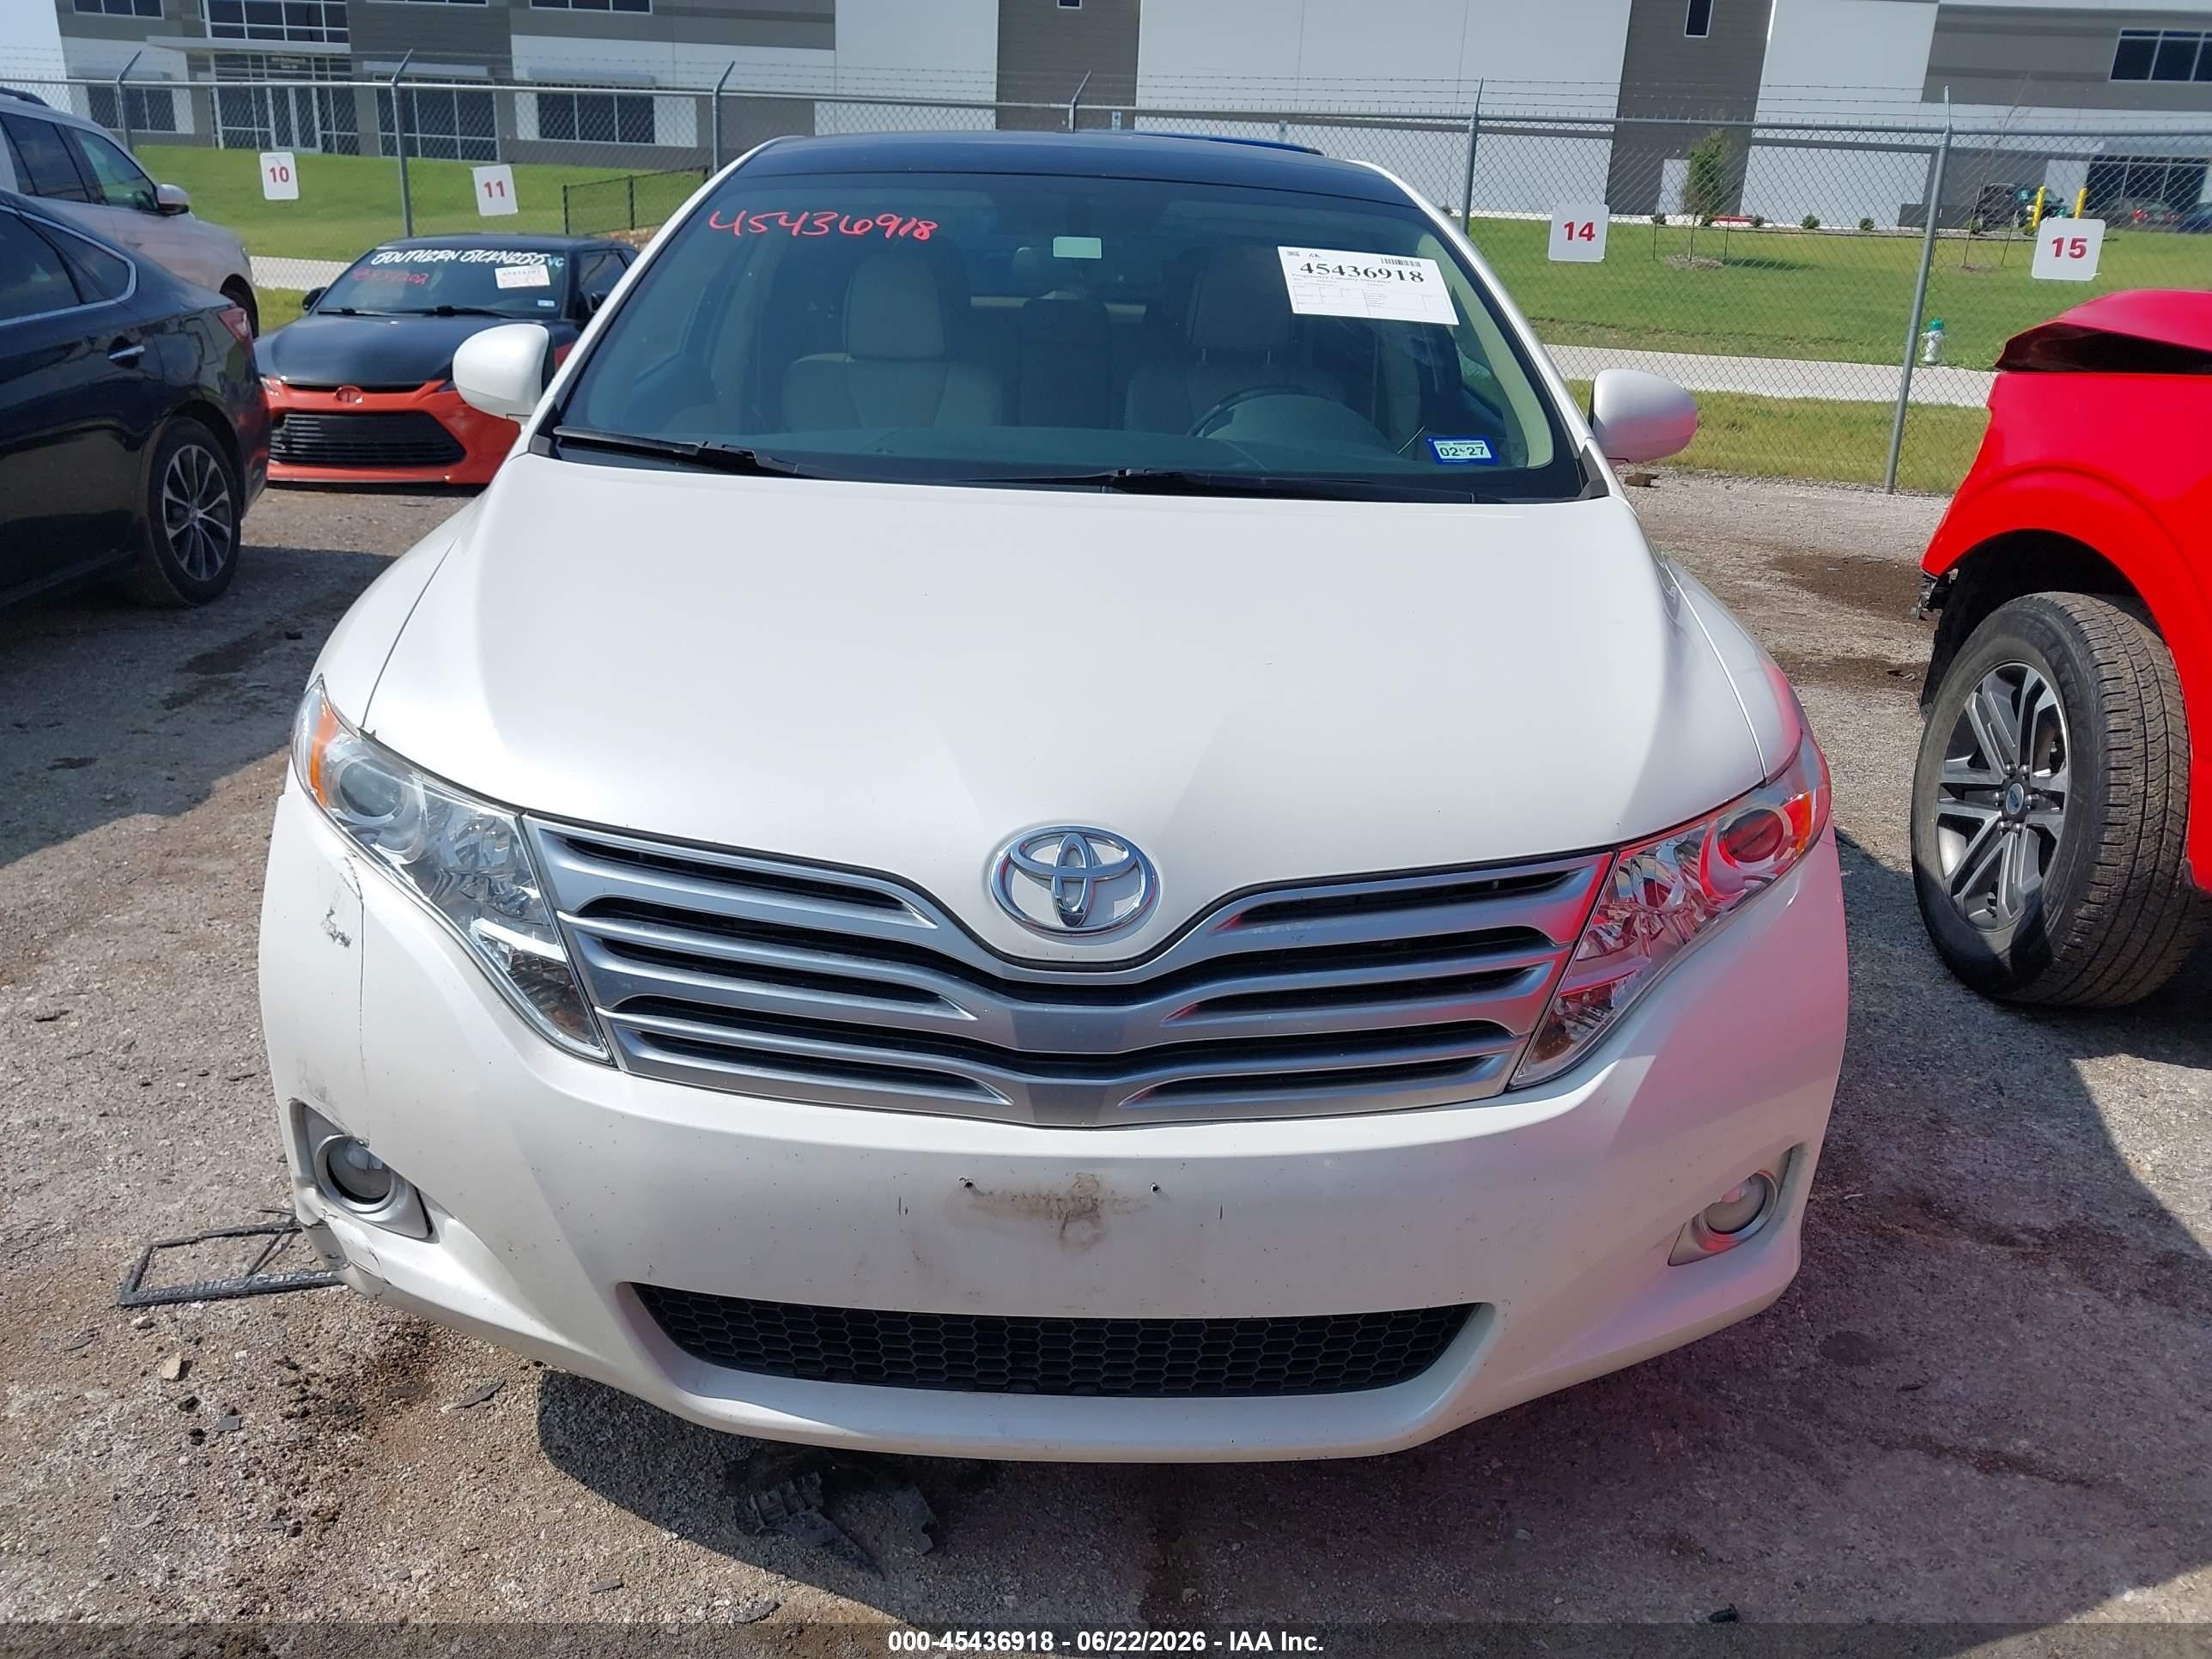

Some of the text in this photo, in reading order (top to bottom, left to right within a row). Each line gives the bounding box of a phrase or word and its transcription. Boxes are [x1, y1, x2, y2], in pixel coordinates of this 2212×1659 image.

[268, 166, 290, 184] 10
[483, 180, 506, 198] 11
[708, 210, 939, 240] 45436918
[1564, 221, 1595, 242] 14
[2051, 236, 2088, 259] 15
[370, 251, 461, 266] SOUTHERN
[1299, 262, 1425, 283] 45436918
[1439, 447, 1485, 457] 02 27
